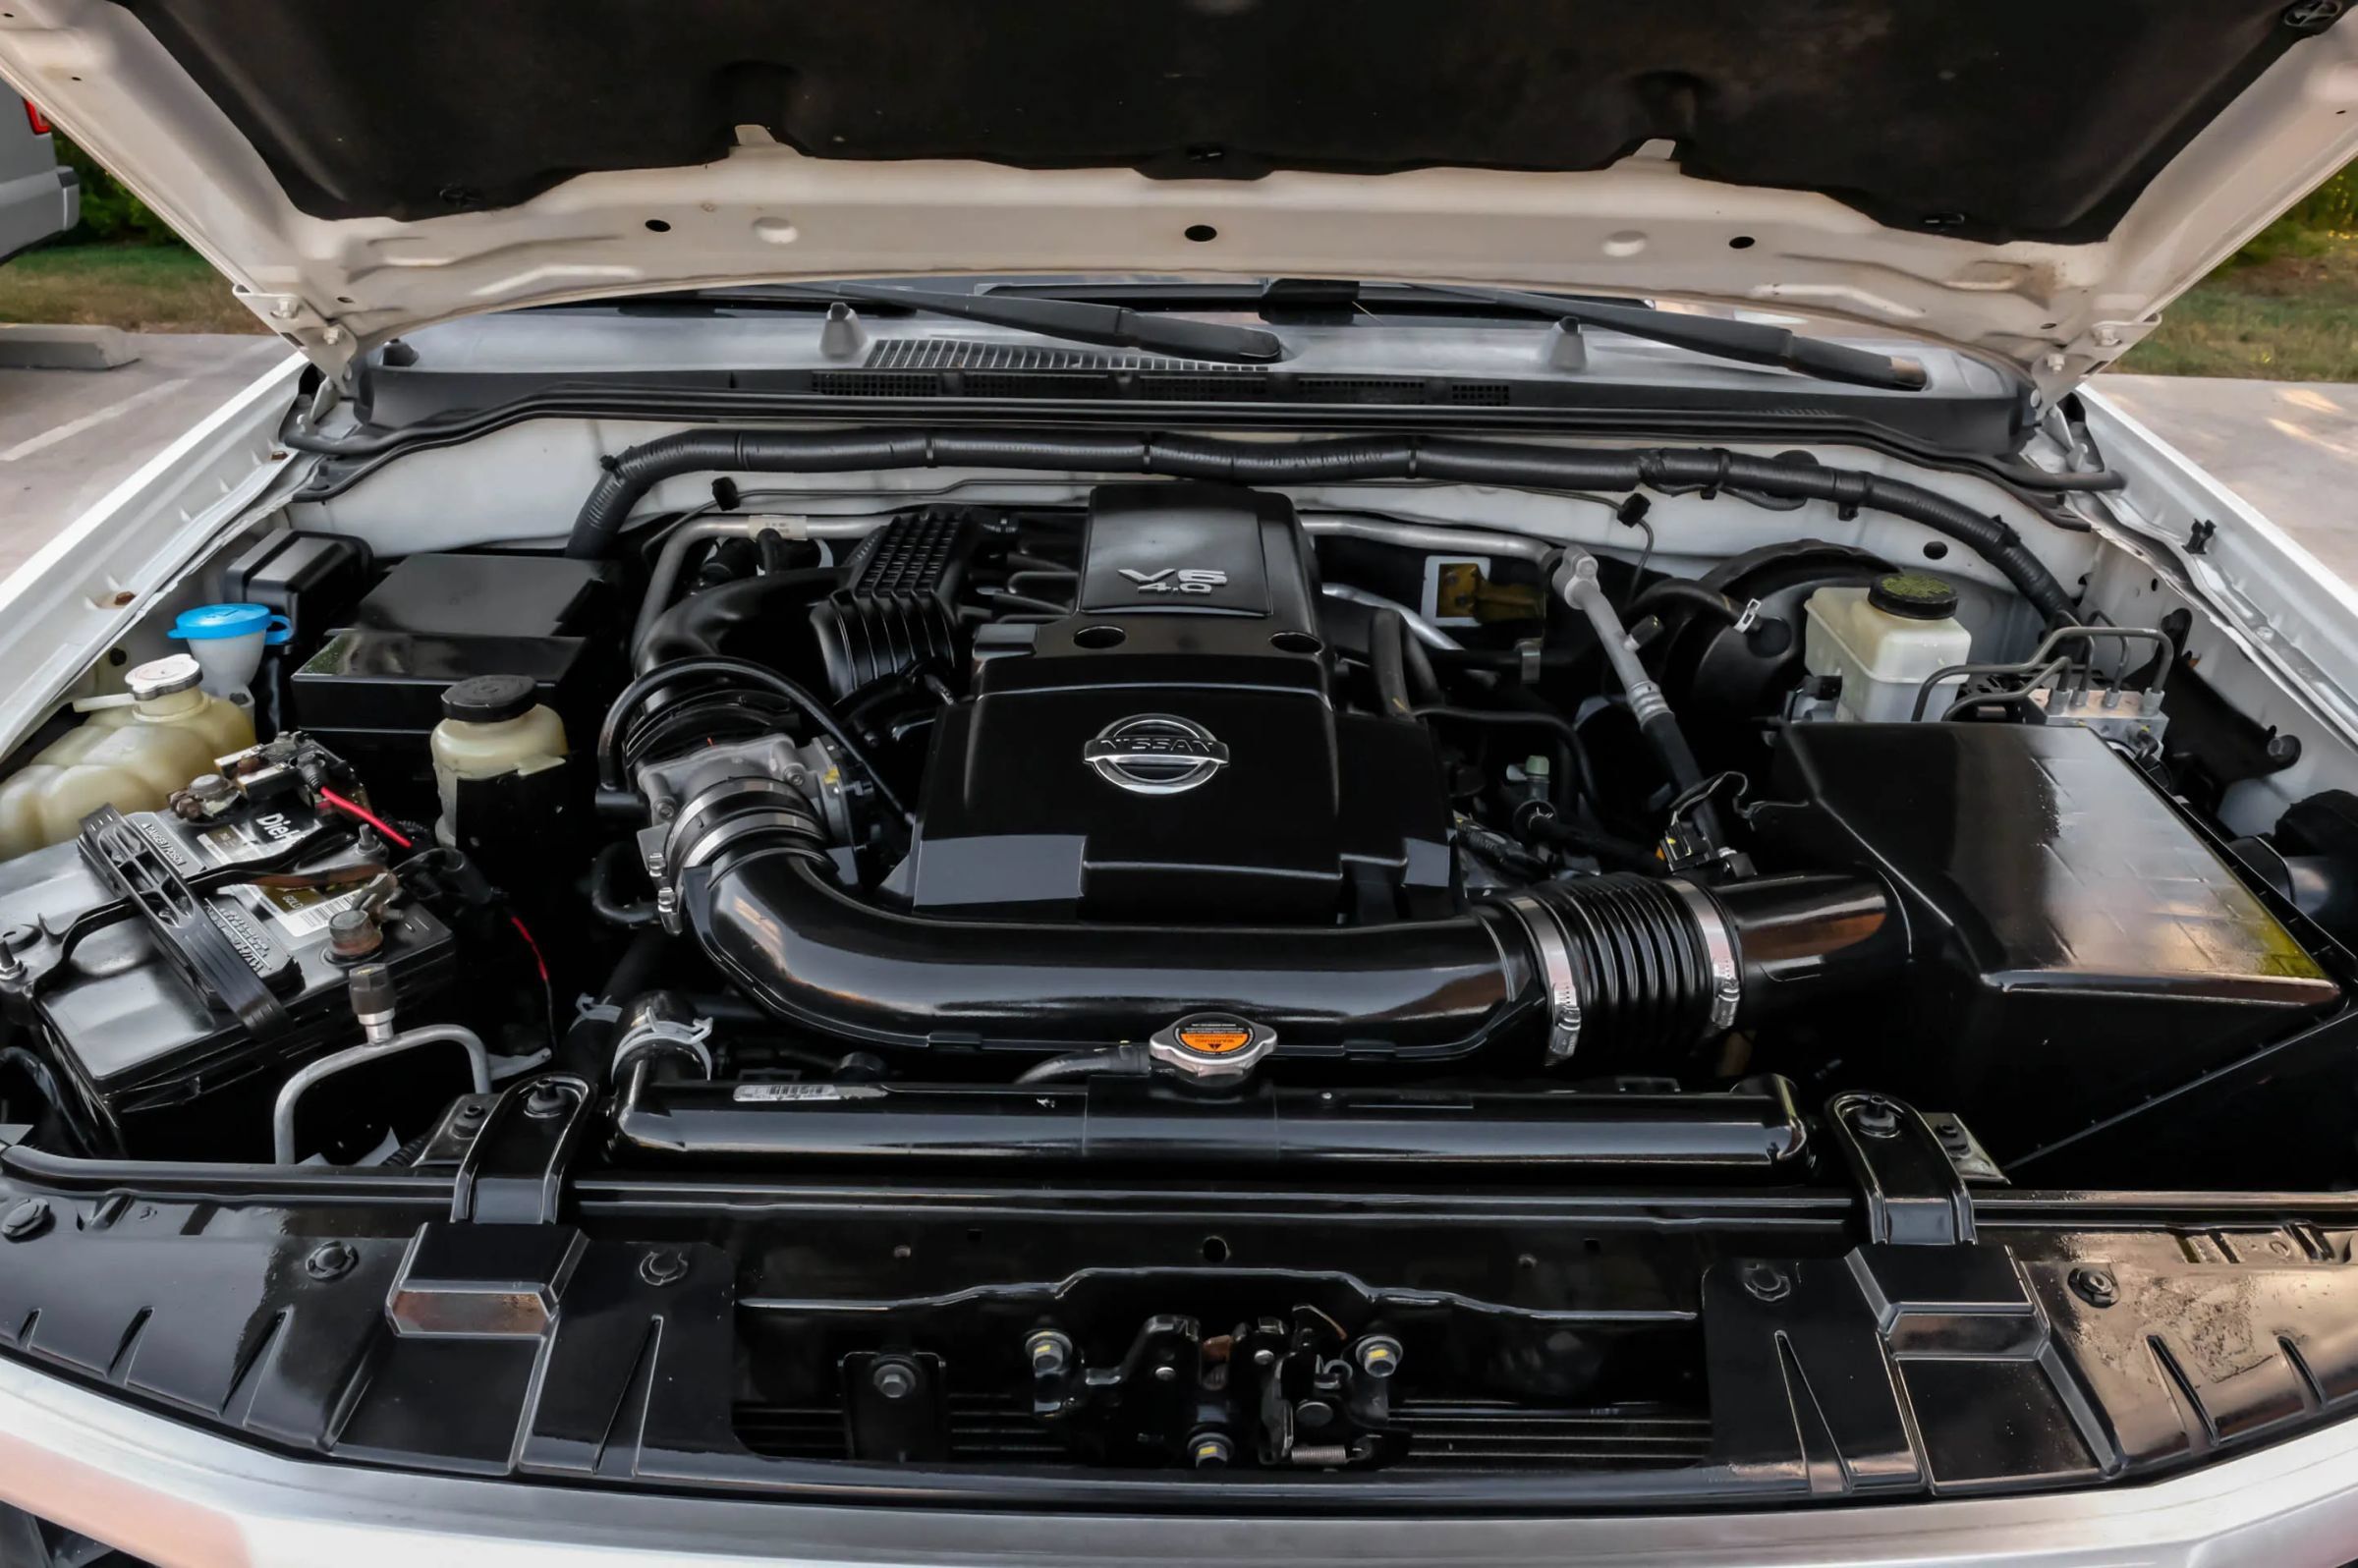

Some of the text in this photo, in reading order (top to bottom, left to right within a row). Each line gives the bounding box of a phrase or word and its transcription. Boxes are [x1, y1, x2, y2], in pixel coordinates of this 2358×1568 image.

[1117, 568, 1228, 585] V6
[1137, 582, 1212, 593] 4.0
[1097, 736, 1215, 755] NISSAN
[282, 895, 304, 910] GOLD
